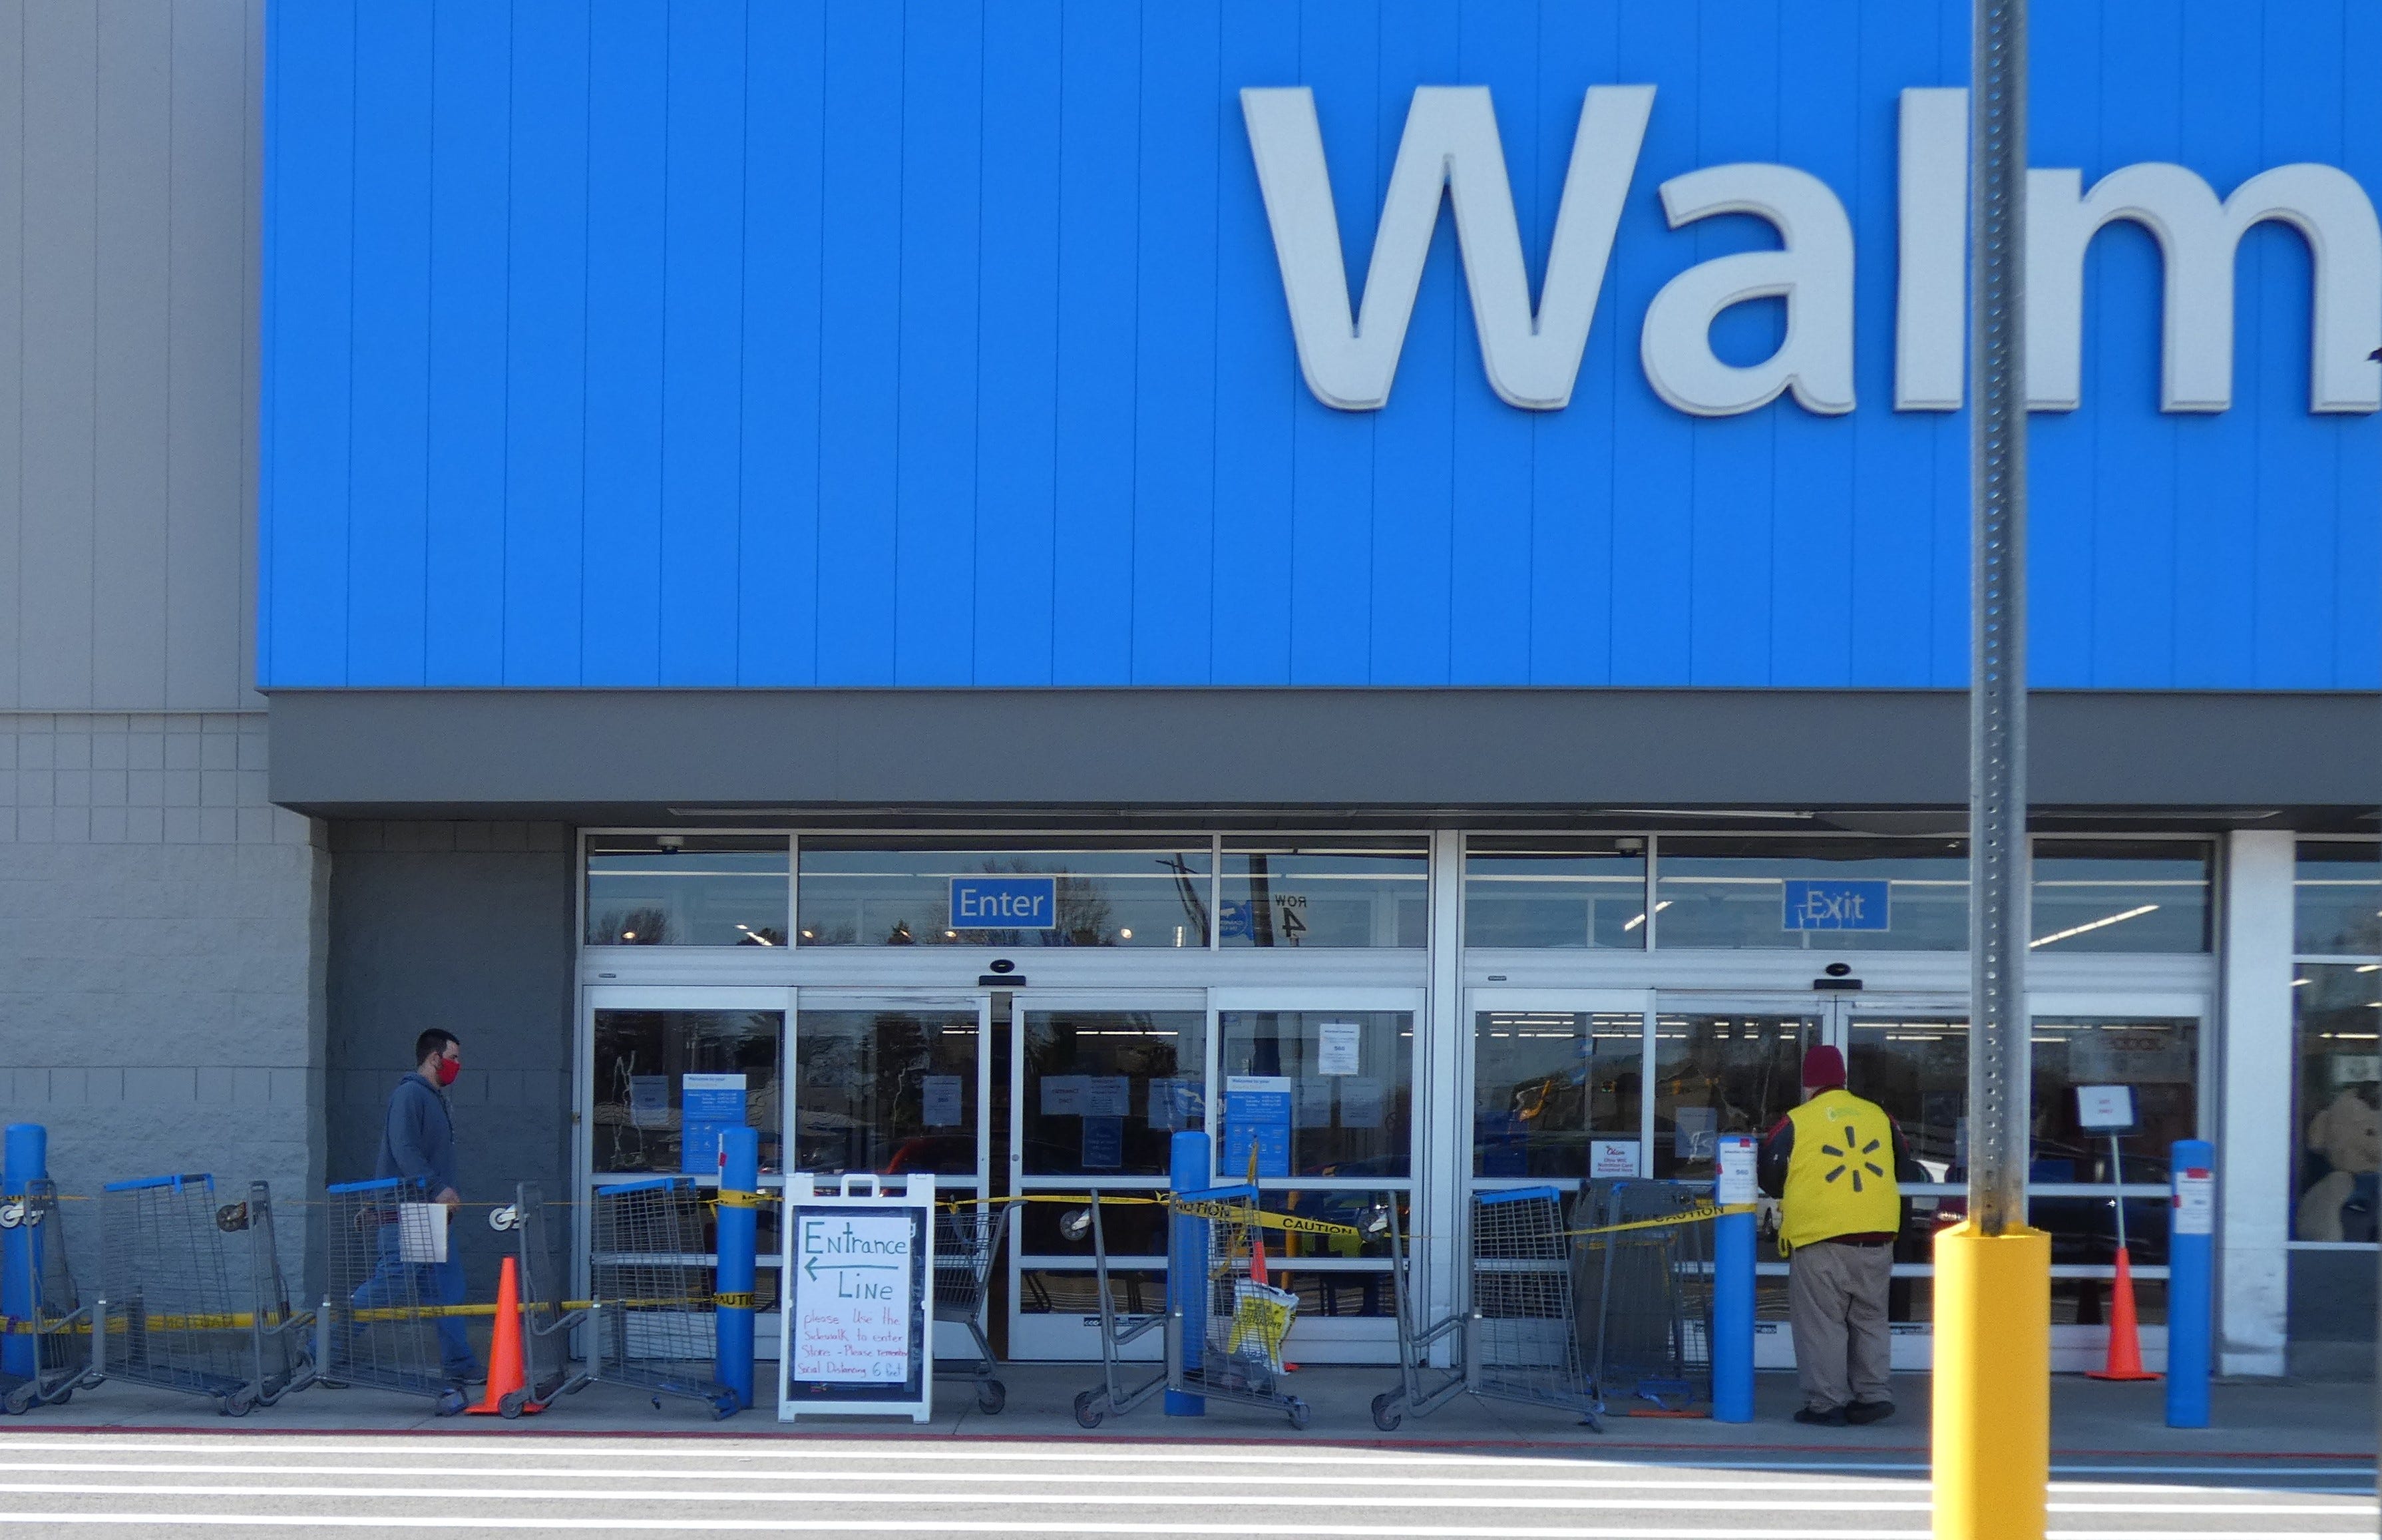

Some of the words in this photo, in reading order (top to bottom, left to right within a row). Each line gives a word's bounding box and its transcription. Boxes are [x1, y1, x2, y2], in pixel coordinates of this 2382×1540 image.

[960, 888, 1044, 916] Enter
[1807, 890, 1864, 919] Exit
[1283, 1218, 1352, 1235] CAUTION
[872, 1362, 881, 1377] 6
